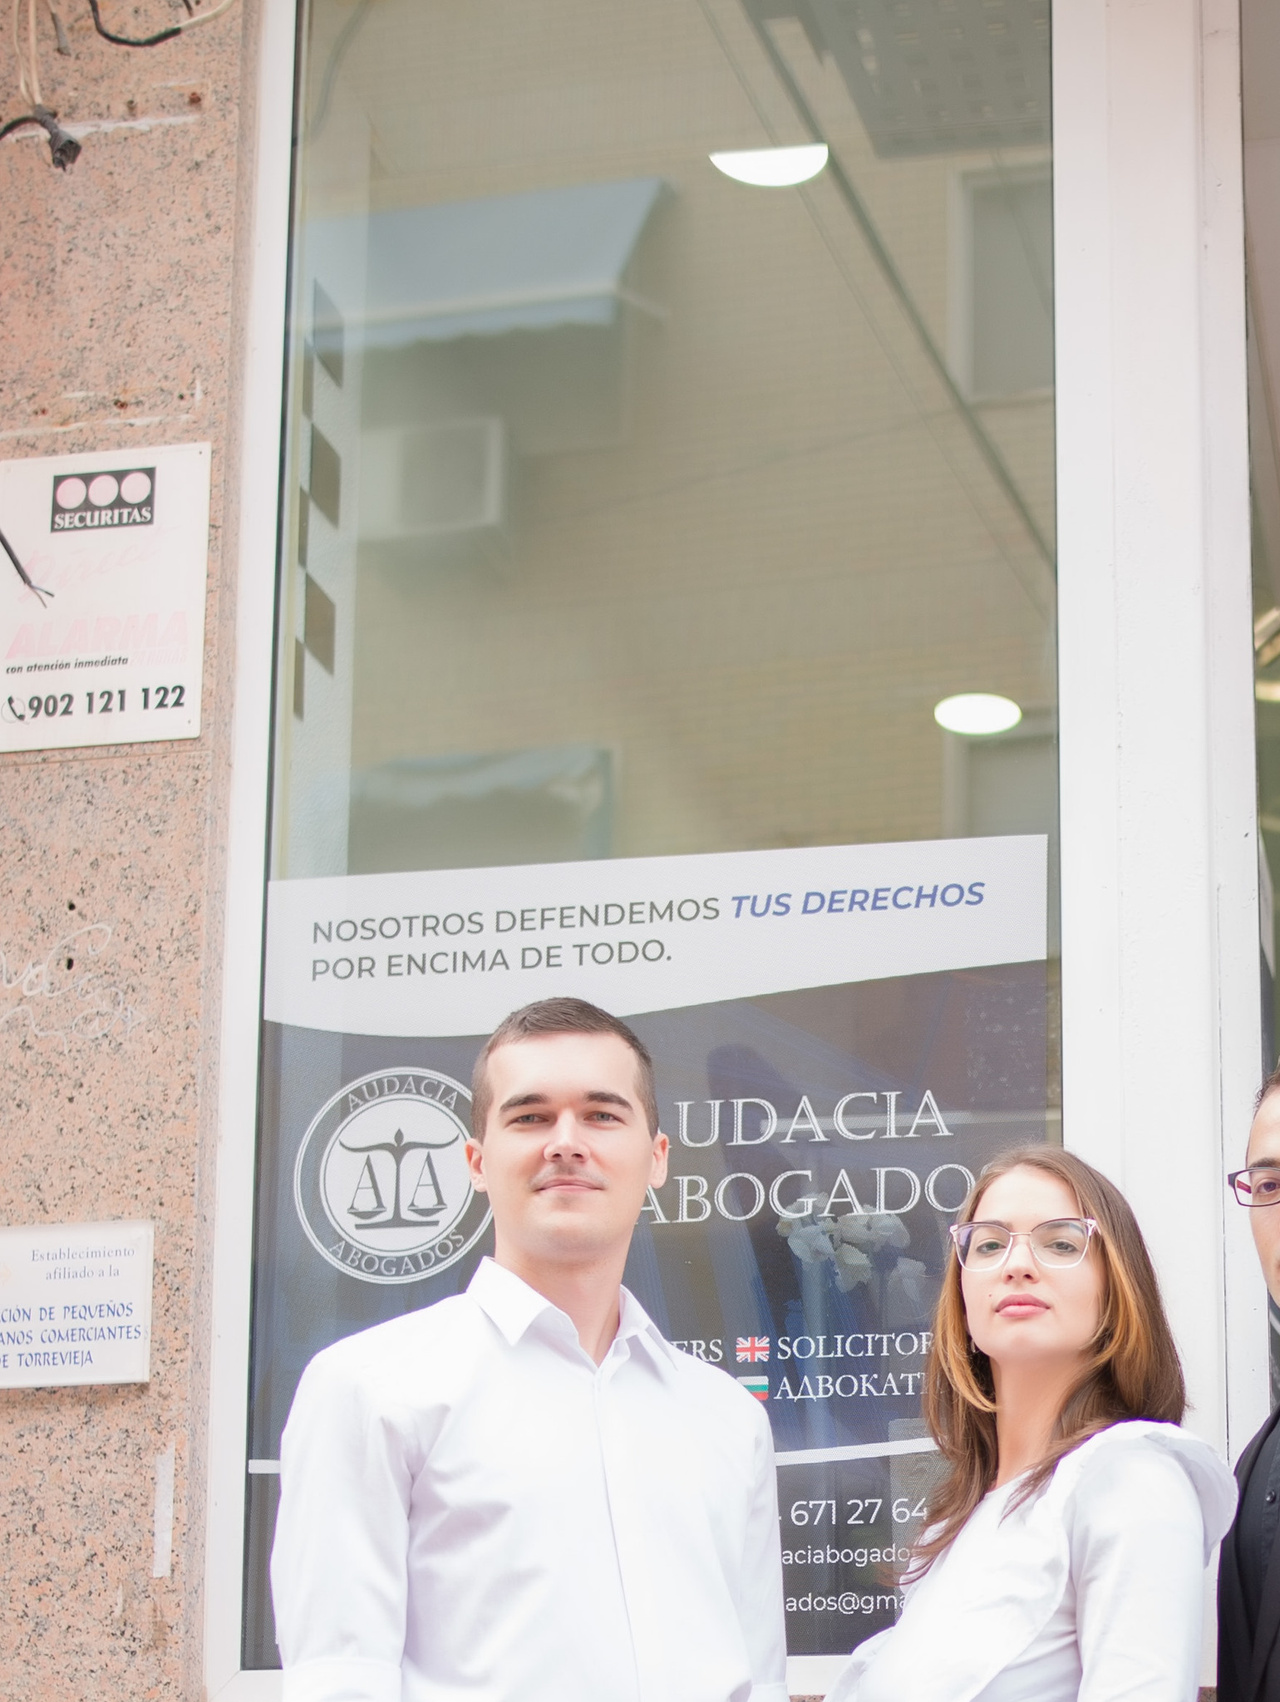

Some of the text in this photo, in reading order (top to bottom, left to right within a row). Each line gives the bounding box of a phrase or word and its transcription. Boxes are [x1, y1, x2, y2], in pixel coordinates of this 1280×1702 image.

[53, 507, 152, 530] SECURITAS
[5, 611, 188, 659] ALARMA
[6, 655, 129, 675] con atención inmediata
[28, 685, 186, 719] 902 121 122
[312, 881, 986, 944] NOSOTROS DEFENDEMOS TUS DERECHOS
[311, 939, 672, 982] POR ENCIMA DE TODO.
[347, 1075, 460, 1113] AUDACIA
[657, 1089, 954, 1149] UDACIA
[31, 1245, 136, 1263] Establecimiento
[328, 1228, 465, 1276] ABOGADOS
[45, 1264, 120, 1280] afiliado a la
[39, 1306, 55, 1321] DE
[63, 1299, 133, 1321] PEQUEÑOS
[40, 1324, 142, 1344] COMERCIANTES
[17, 1350, 93, 1368] TORREVIEJA
[790, 1500, 836, 1525] 671
[846, 1499, 882, 1524] 27
